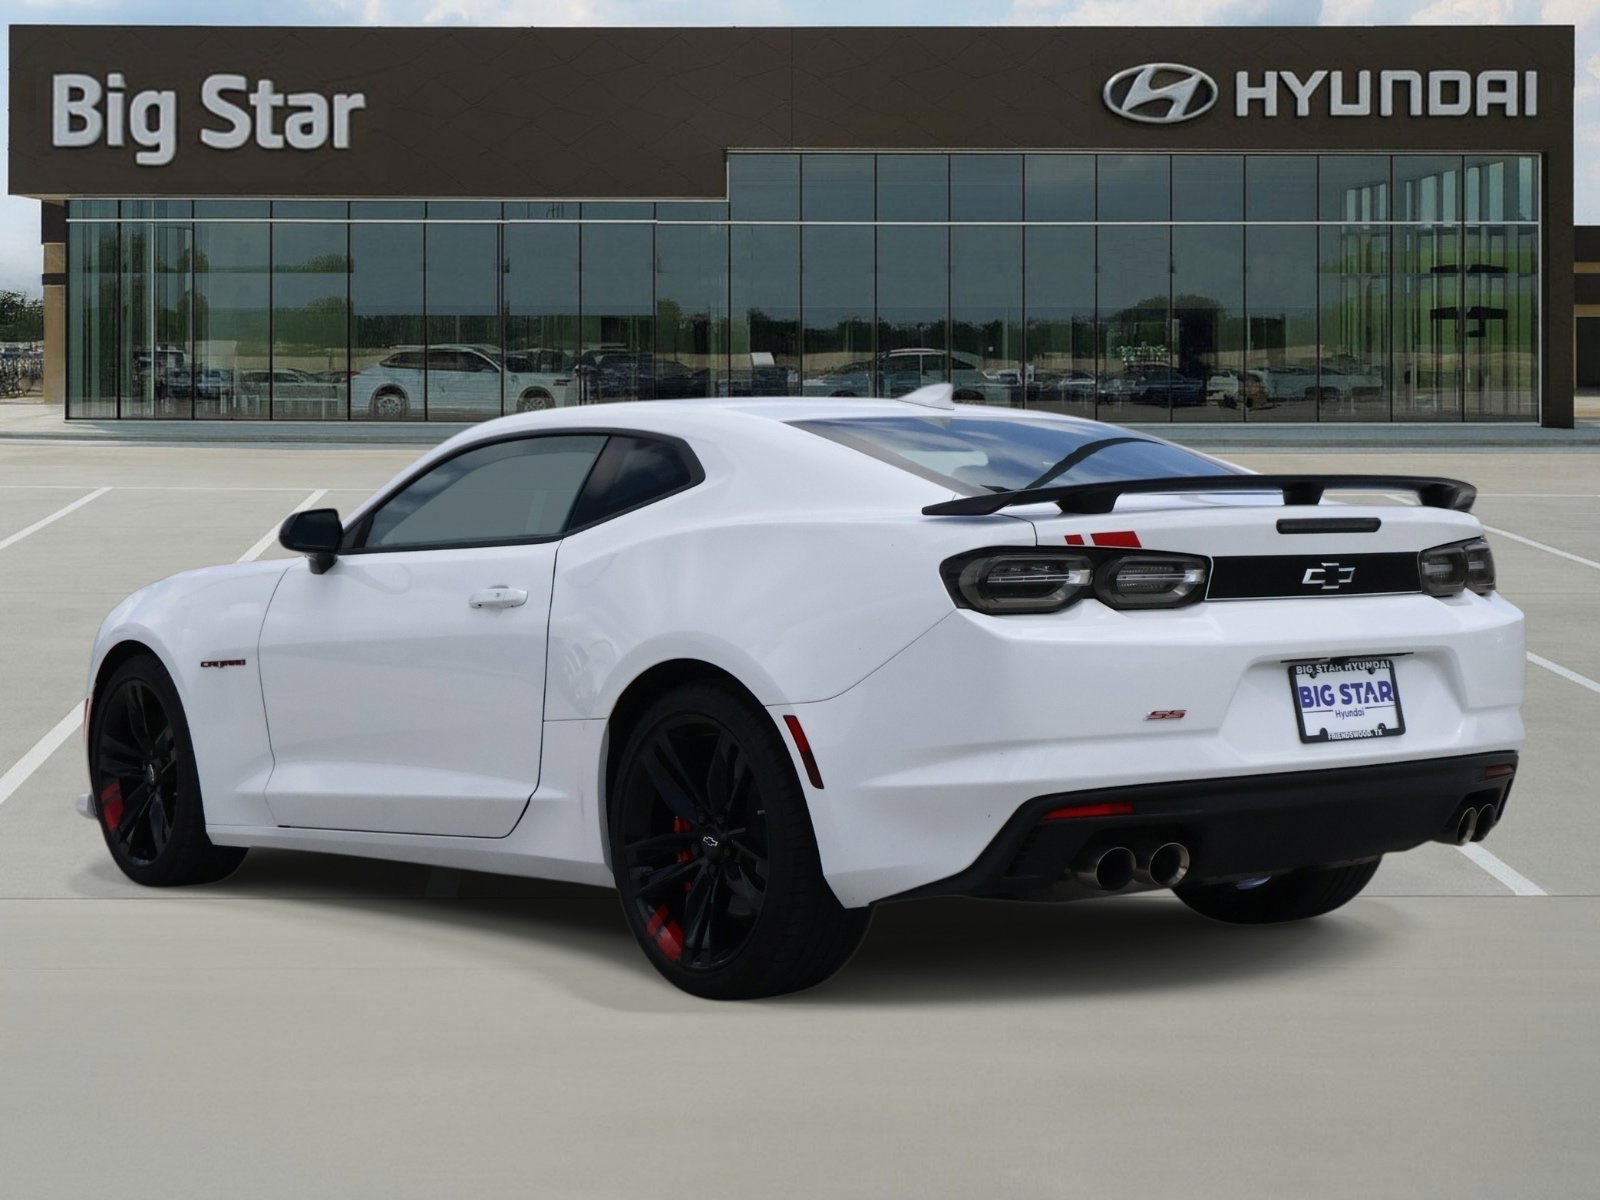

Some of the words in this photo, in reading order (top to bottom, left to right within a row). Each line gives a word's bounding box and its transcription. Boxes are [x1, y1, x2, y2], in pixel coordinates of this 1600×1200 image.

[1235, 70, 1538, 117] HYUNDAI
[52, 73, 177, 165] Big
[200, 73, 366, 151] Star
[1296, 665, 1313, 674] BIG
[1345, 660, 1391, 671] HYUNDAI
[1298, 684, 1336, 708] BIG
[1339, 680, 1394, 705] STAR
[1335, 708, 1365, 719] Hyundai
